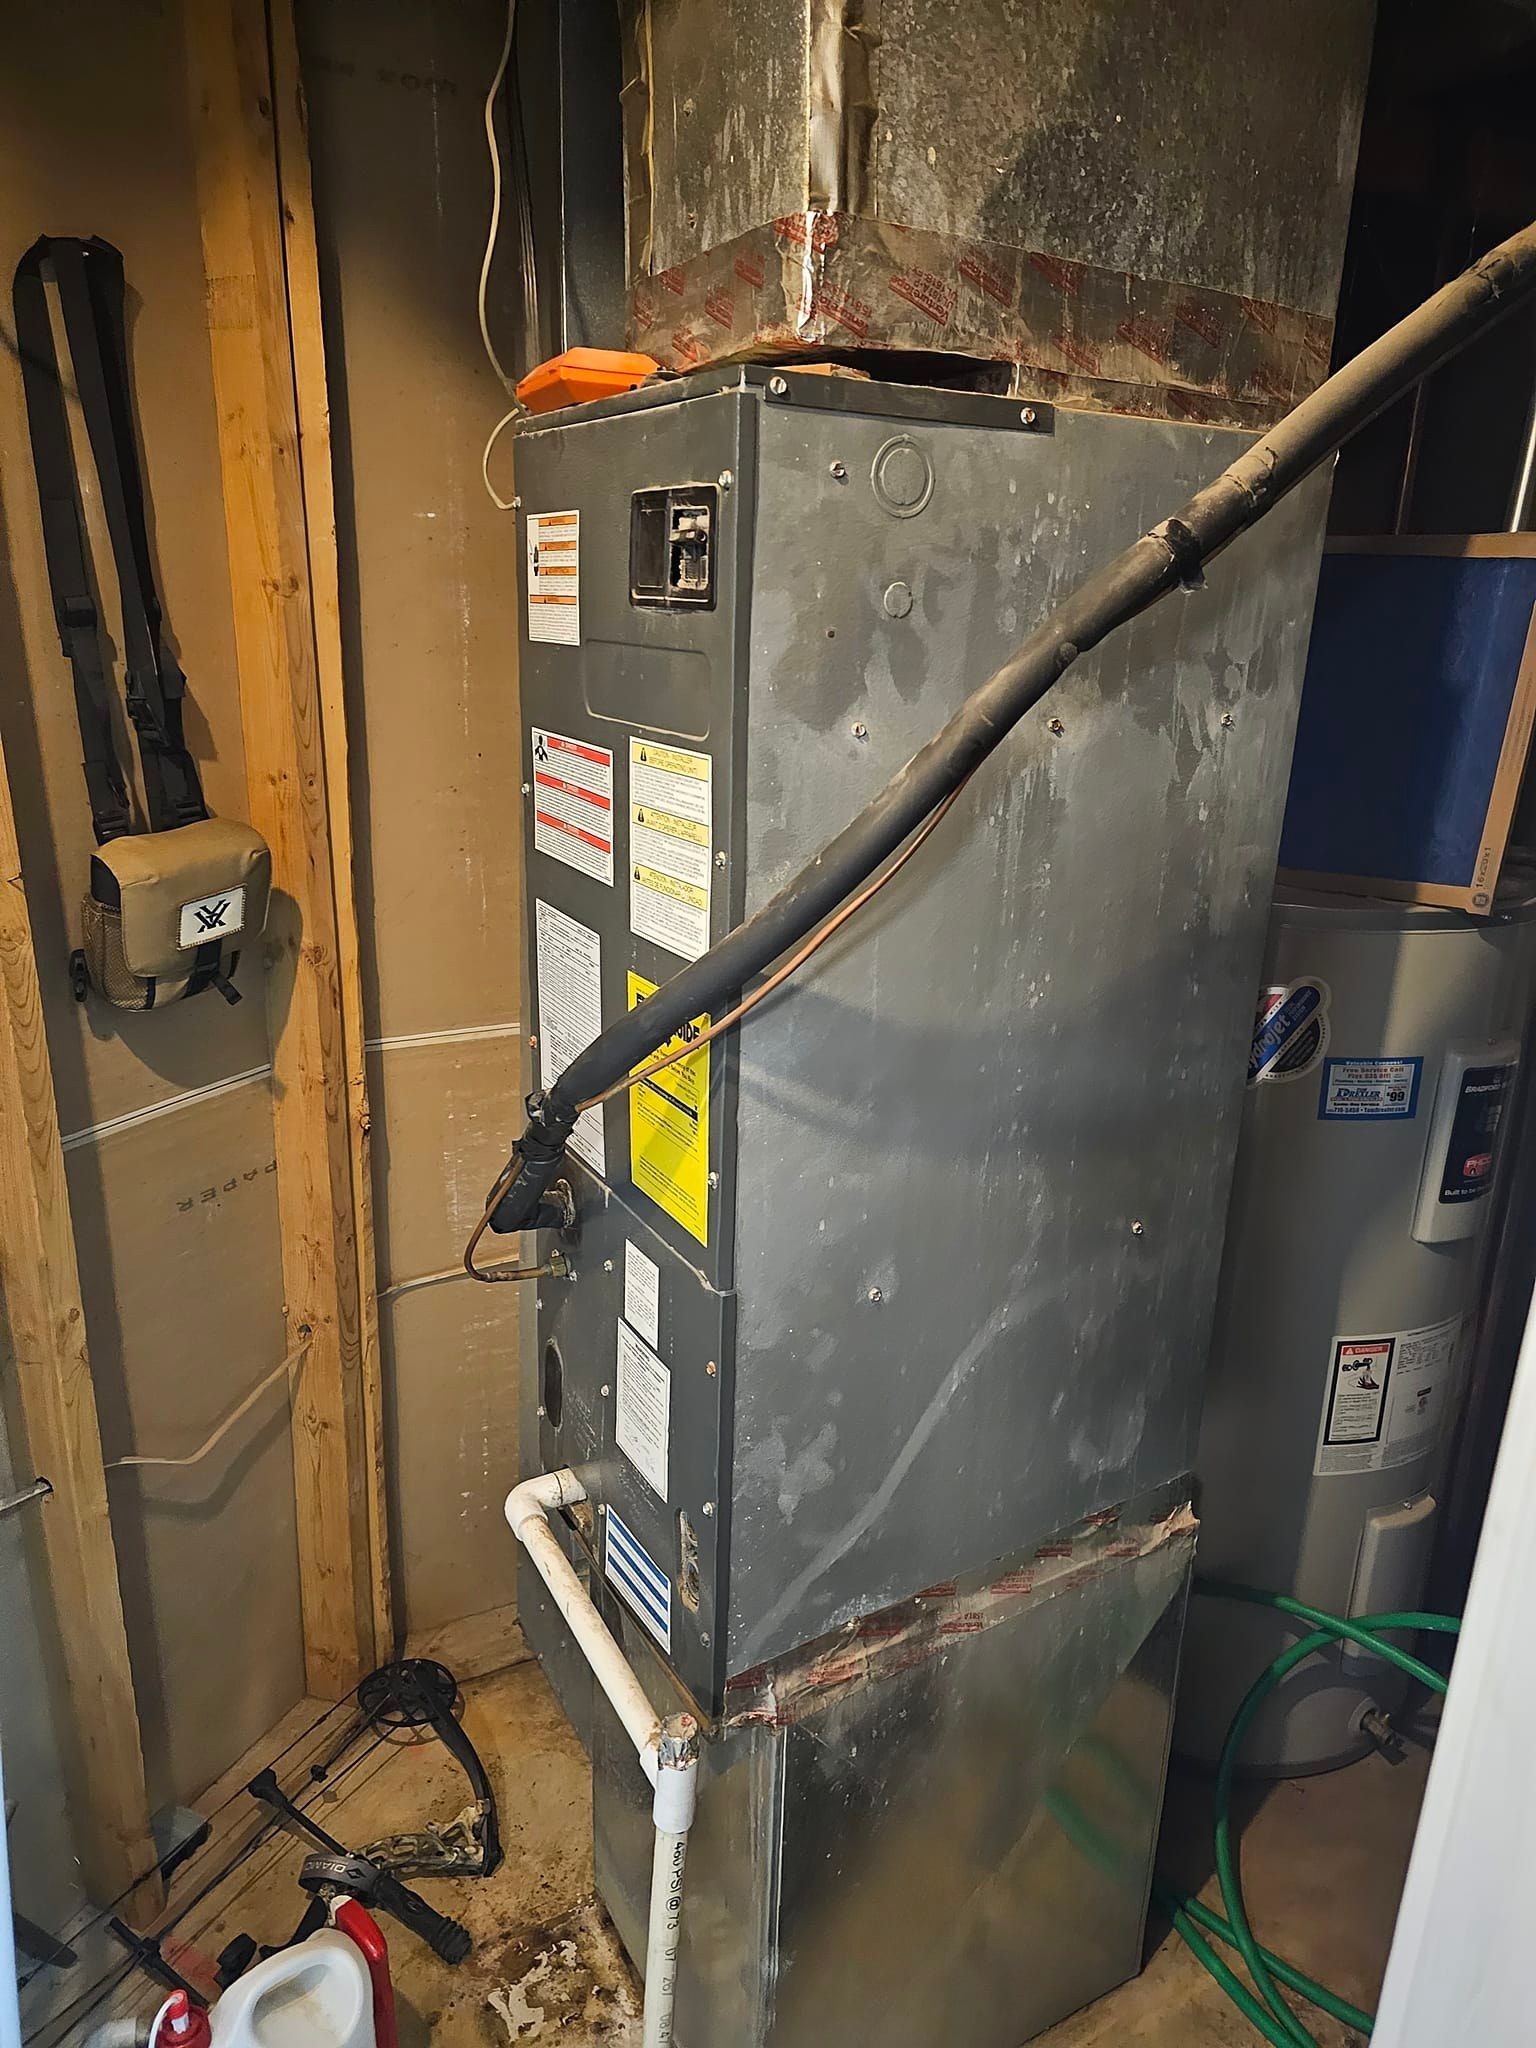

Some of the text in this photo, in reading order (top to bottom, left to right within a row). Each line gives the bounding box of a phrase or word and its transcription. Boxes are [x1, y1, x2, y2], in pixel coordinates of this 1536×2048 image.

[888, 272, 951, 320] VentureTape
[1248, 1013, 1291, 1069] ydrojet
[1387, 1092, 1404, 1101] $99
[175, 1159, 278, 1213] PAPER
[669, 1866, 683, 1893] PSI
[665, 1895, 681, 1912] @
